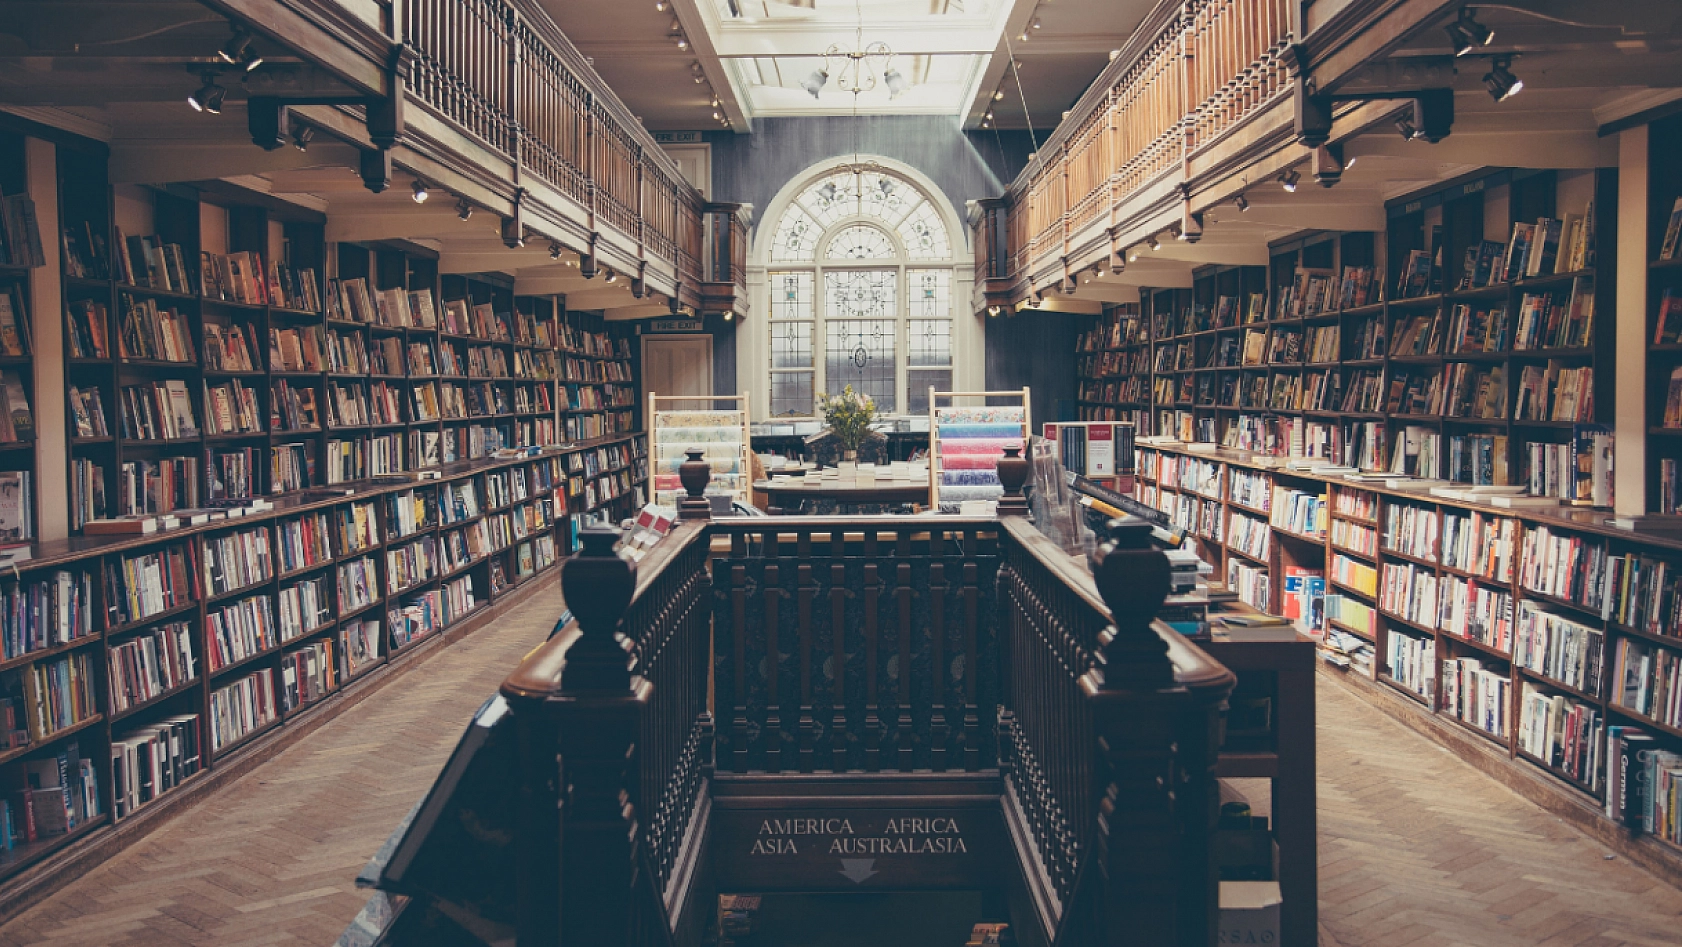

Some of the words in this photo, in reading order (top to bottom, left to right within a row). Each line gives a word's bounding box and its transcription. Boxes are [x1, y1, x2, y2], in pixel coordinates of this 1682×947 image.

[677, 133, 696, 141] EXIT
[759, 818, 854, 835] AMERICA
[884, 818, 959, 834] AFRICA
[750, 838, 798, 854] ASIA
[829, 837, 967, 853] AUSTRALASIA
